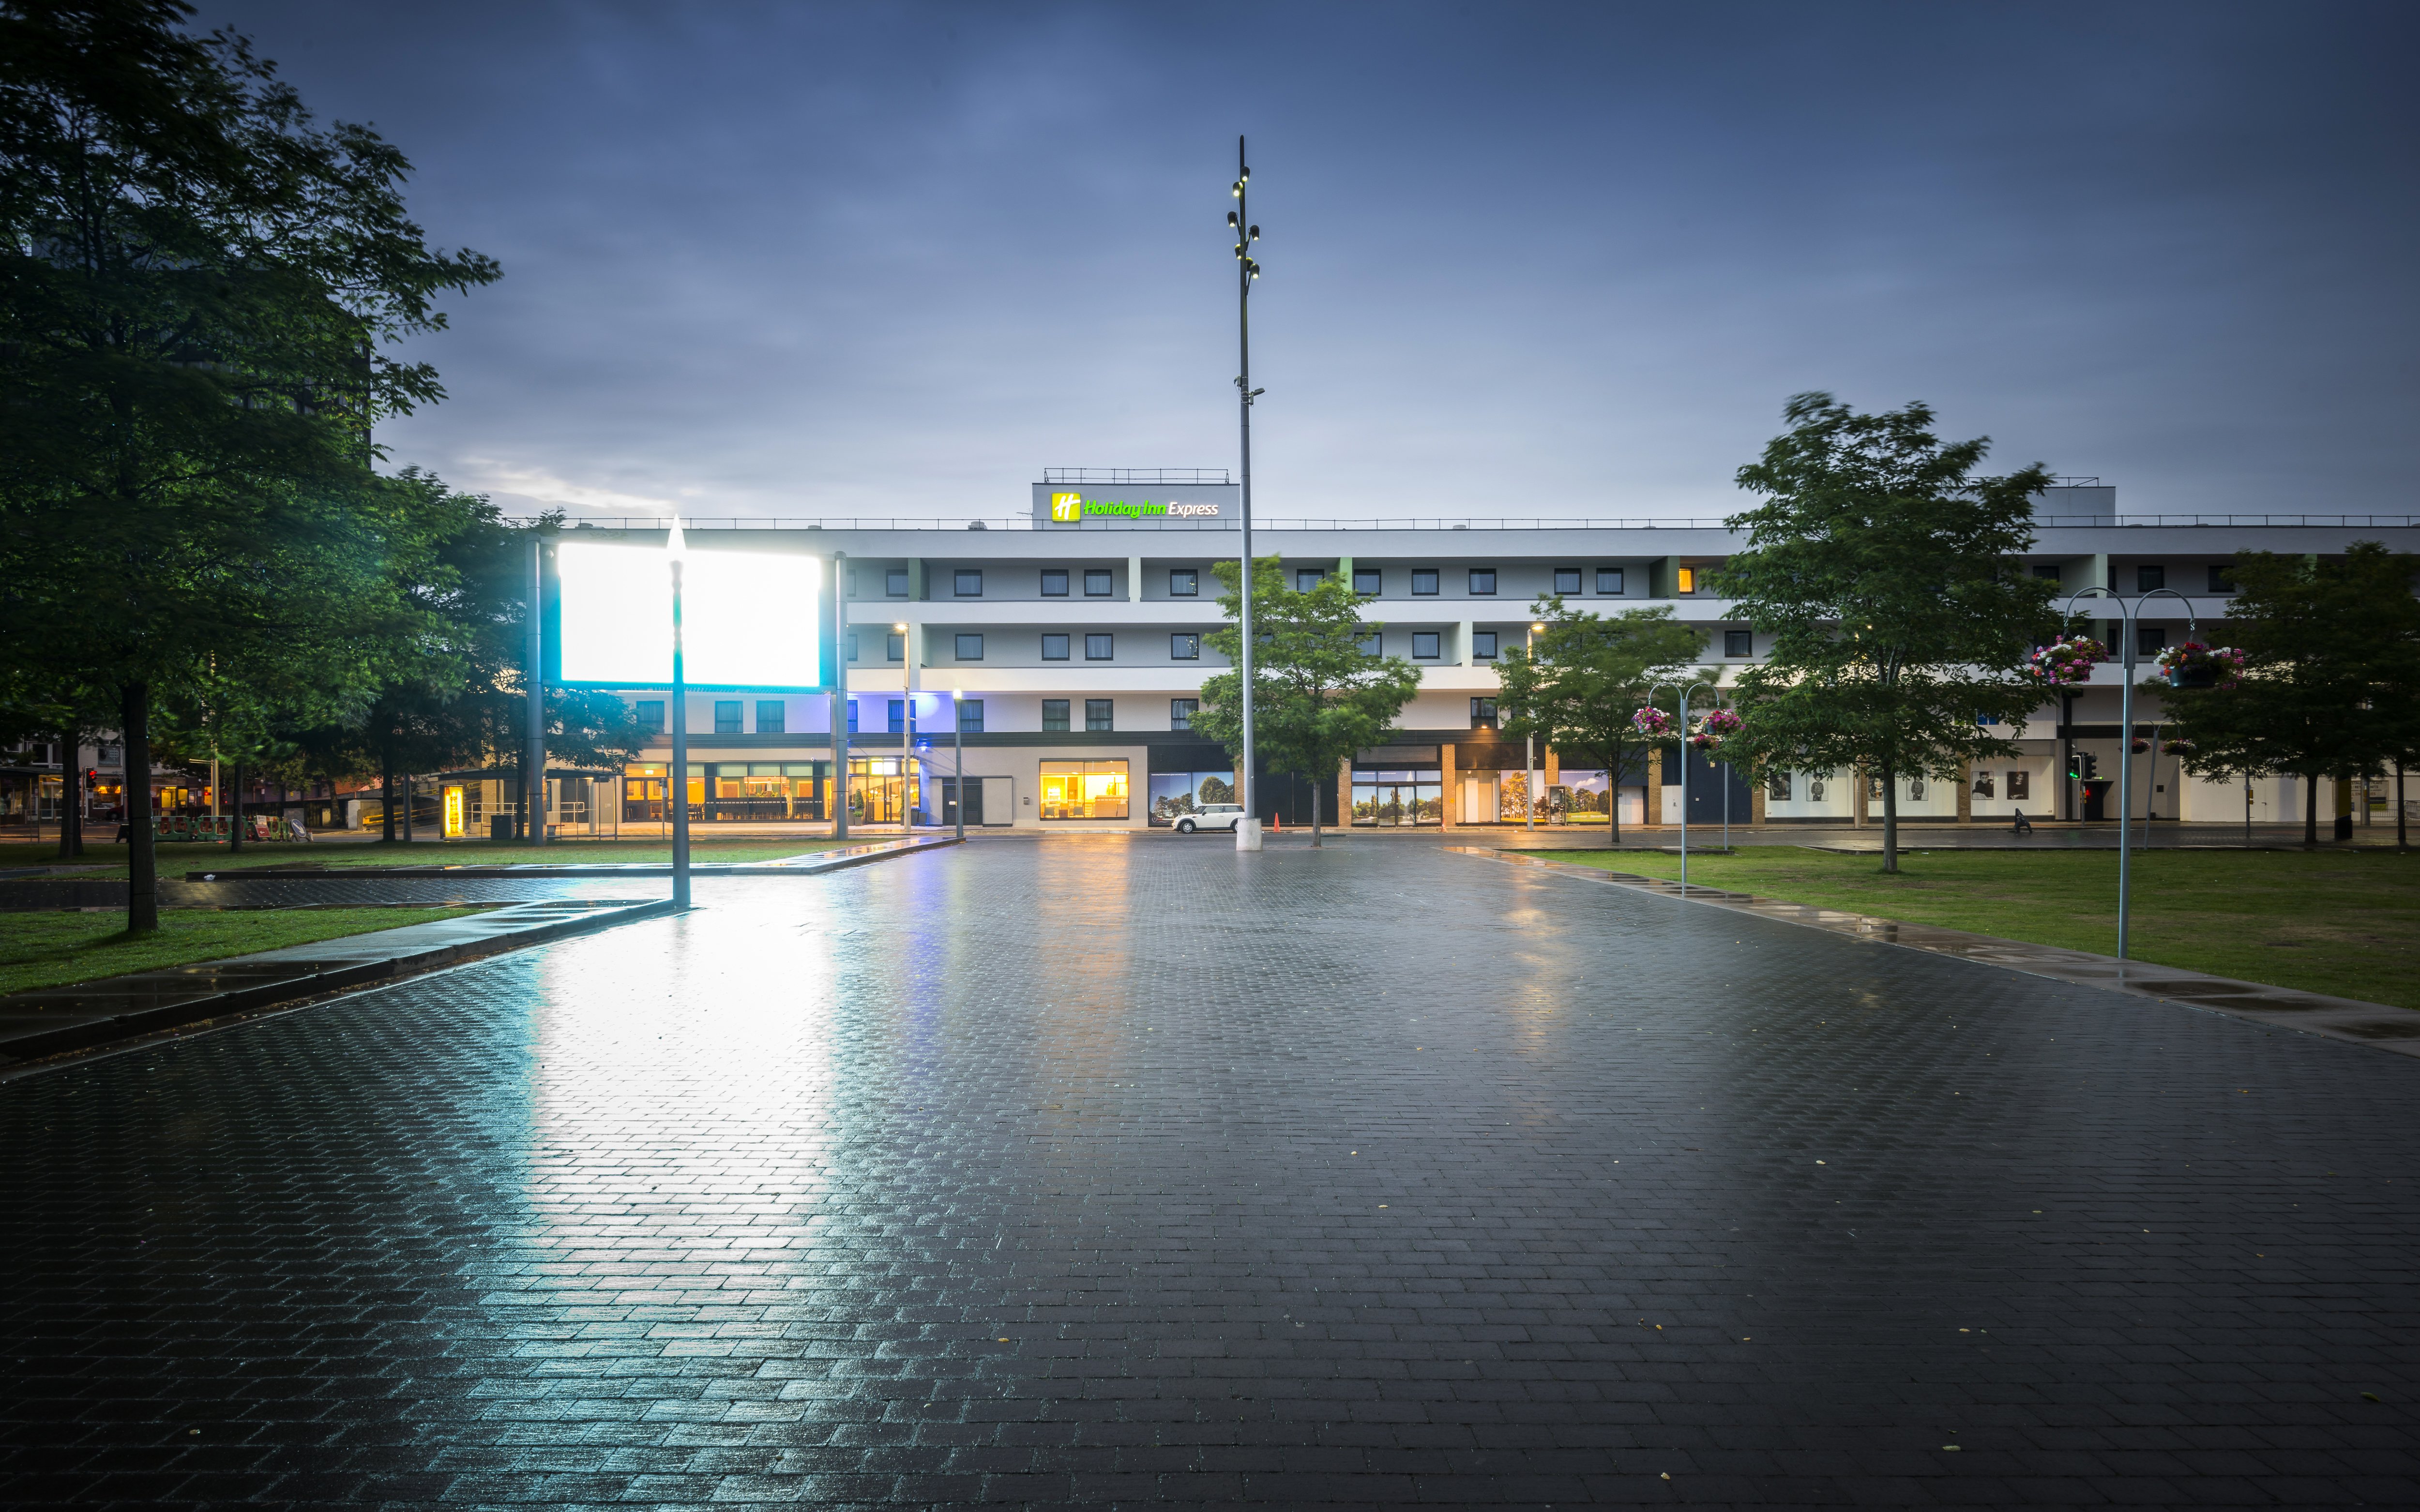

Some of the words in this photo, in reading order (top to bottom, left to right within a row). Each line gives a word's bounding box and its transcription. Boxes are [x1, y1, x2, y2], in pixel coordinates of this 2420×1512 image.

[1084, 500, 1141, 518] Holiday
[1143, 500, 1166, 515] Inn
[1168, 502, 1218, 518] Express
